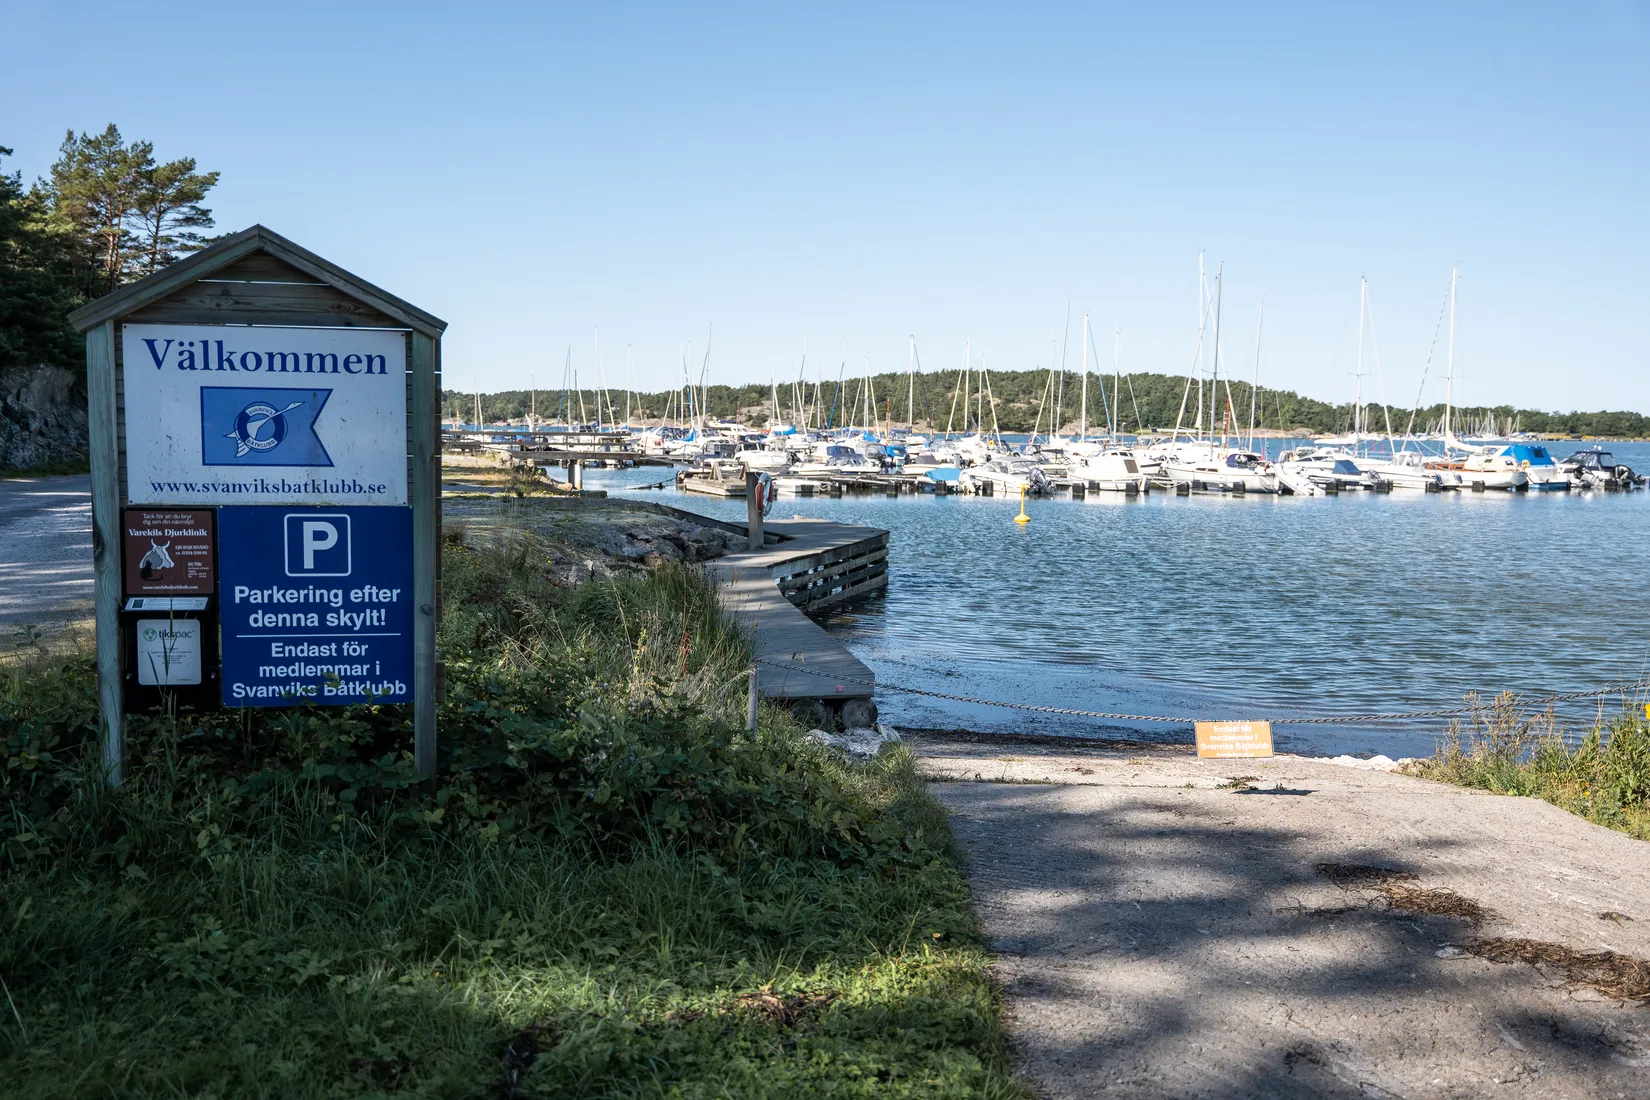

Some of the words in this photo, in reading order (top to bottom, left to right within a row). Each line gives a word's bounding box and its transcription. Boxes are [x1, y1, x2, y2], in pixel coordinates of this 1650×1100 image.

[142, 338, 388, 375] Välkommen
[248, 406, 275, 416] SVANVIKS
[246, 438, 276, 449] BÅTKLUBB
[150, 478, 387, 495] www.svanviksbatklubb.se
[181, 513, 192, 521] bryr
[128, 528, 163, 536] Varekils
[164, 528, 208, 538] Djurklinik
[303, 521, 339, 569] P
[234, 585, 343, 607] Parkering
[350, 584, 401, 603] efter
[249, 609, 319, 628] denna
[326, 608, 386, 630] skylt!
[271, 643, 337, 658] Endast
[342, 641, 369, 657] för
[259, 662, 370, 678] medlemmar
[375, 661, 380, 676] i
[232, 682, 318, 698] Svanviks
[324, 680, 407, 696] Båtklubb
